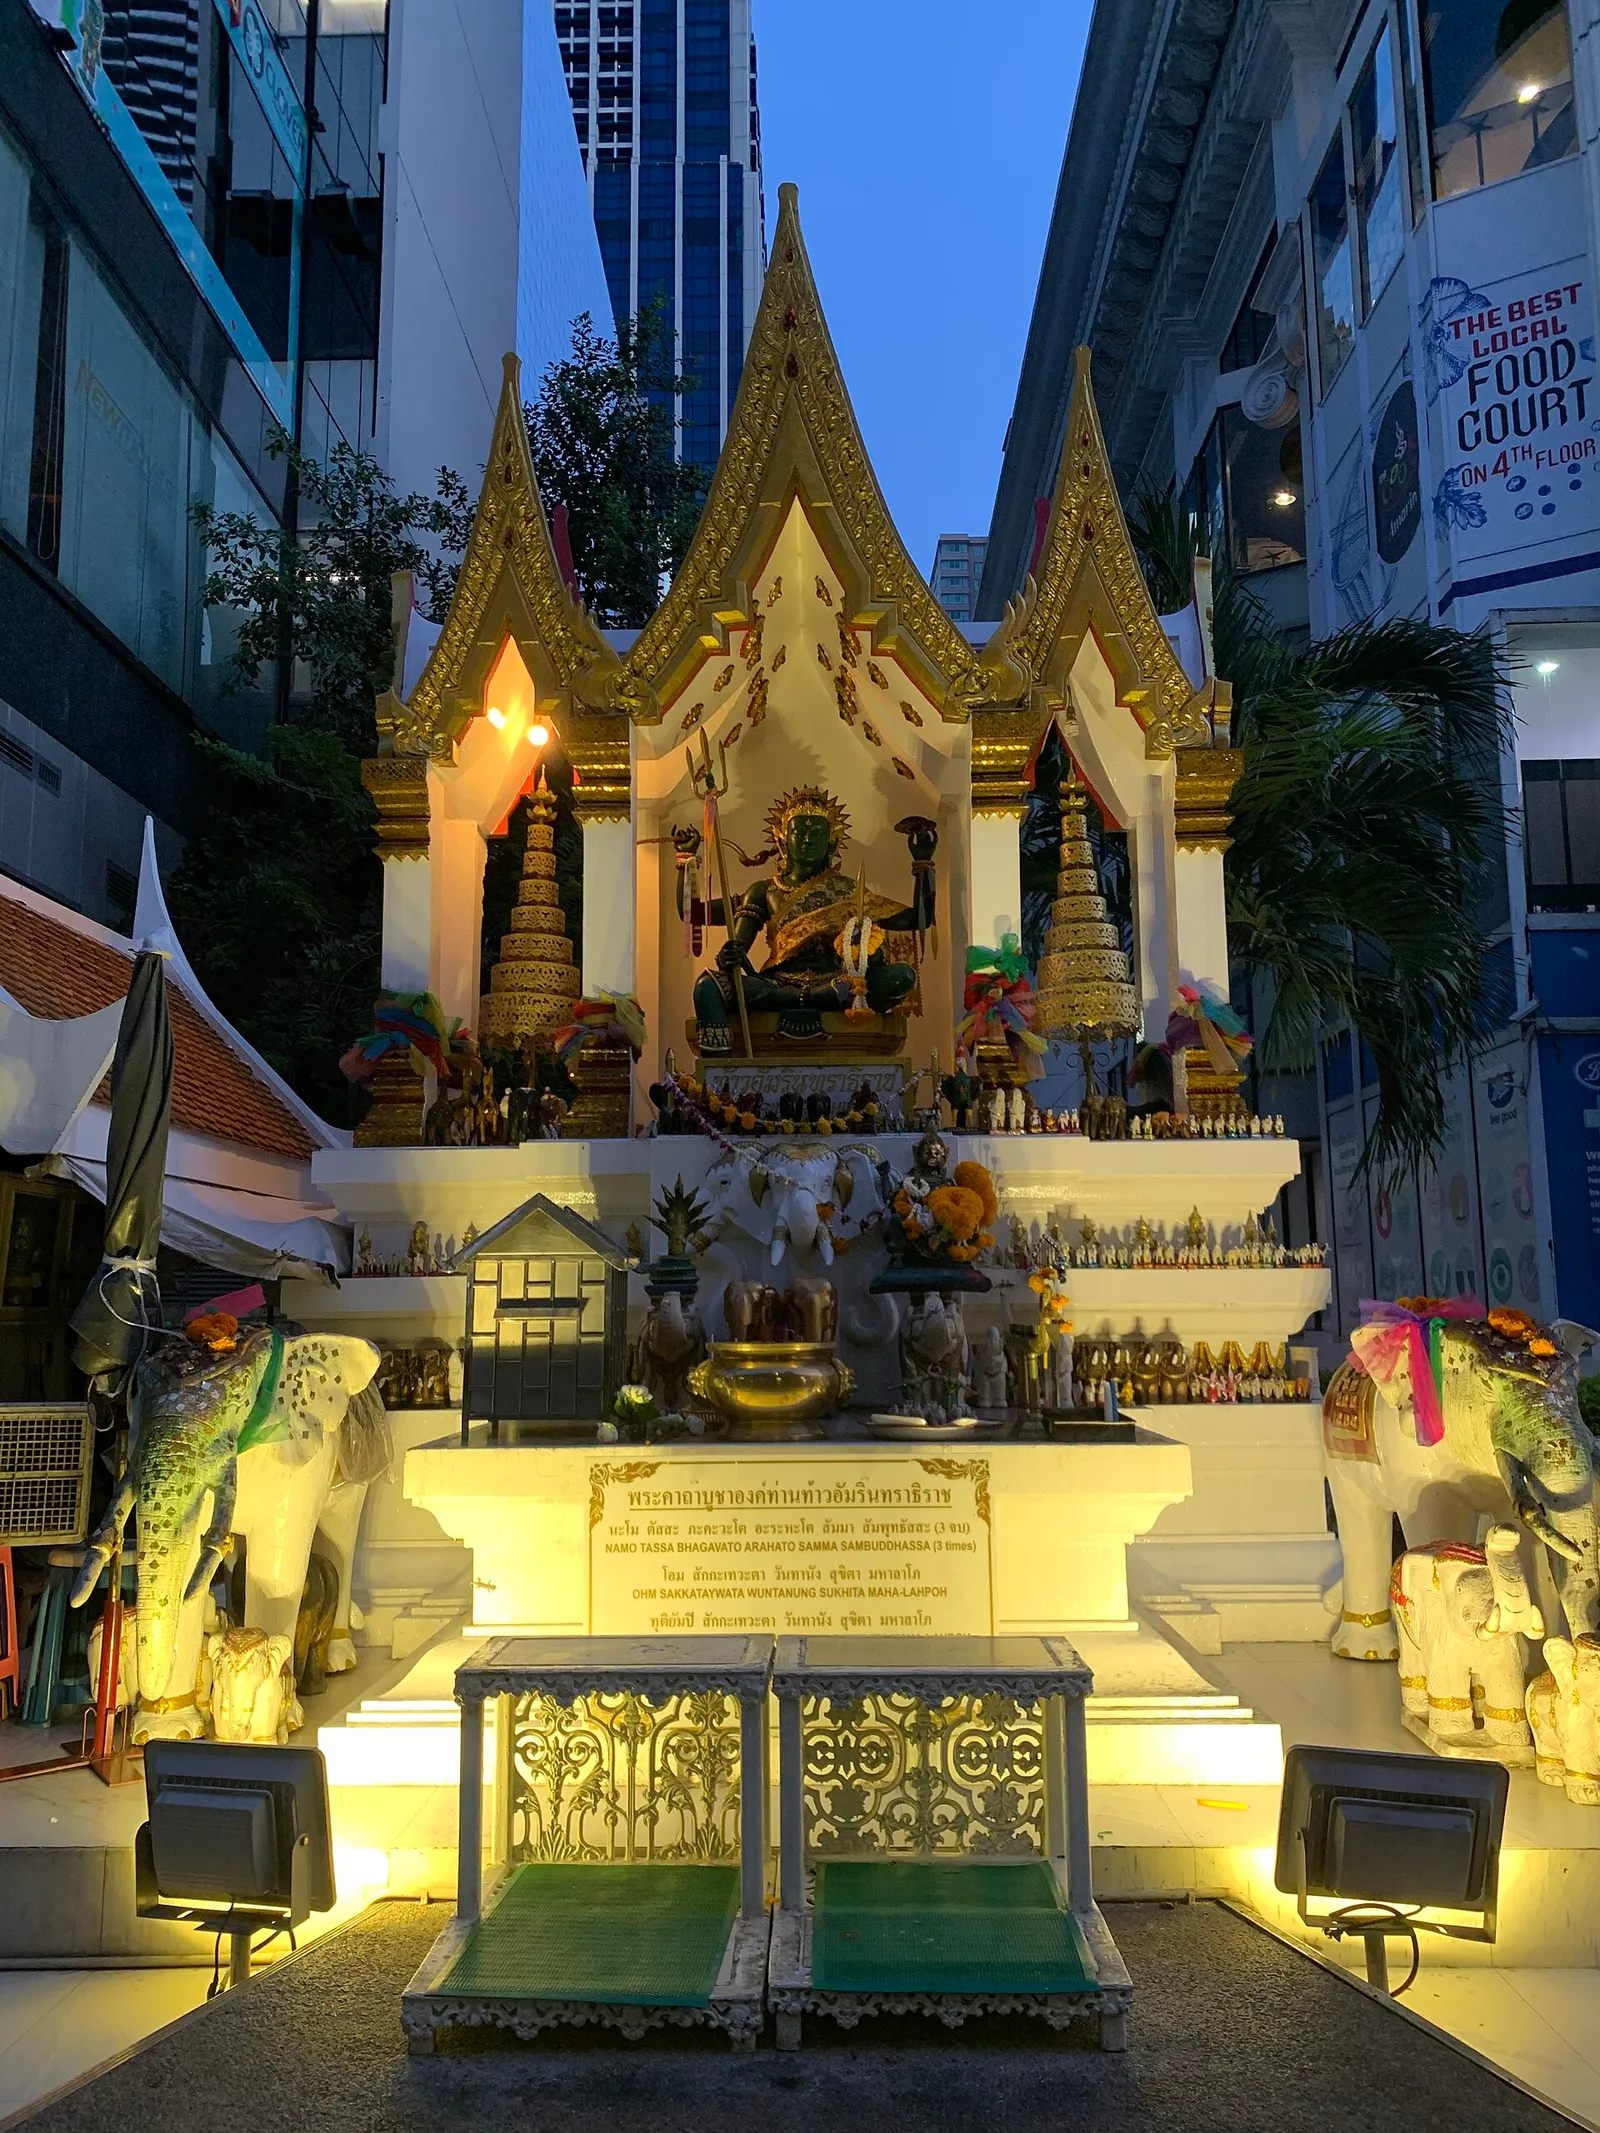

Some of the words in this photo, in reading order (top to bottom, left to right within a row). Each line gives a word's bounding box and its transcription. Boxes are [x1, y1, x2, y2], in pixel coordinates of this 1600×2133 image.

[1448, 307, 1503, 340] THE
[1508, 282, 1583, 323] BEST
[1472, 315, 1568, 359] LOCAL
[1467, 338, 1576, 406] FOOD
[1457, 376, 1593, 452] COURT
[1461, 463, 1488, 488] ON
[1491, 442, 1533, 479] 4TH
[1535, 438, 1597, 470] FLOOR
[609, 1520, 639, 1536] นะโม
[647, 1520, 679, 1536] ตัสสะ
[688, 1518, 747, 1535] ภะคะวะโต
[755, 1518, 814, 1535] อะระหะโต
[822, 1518, 854, 1534] สัมมา
[862, 1518, 931, 1537] สัมพุทธัสสะ
[934, 1522, 946, 1536] (3
[949, 1522, 970, 1536] จบ)
[605, 1542, 637, 1553] NAMO
[640, 1542, 675, 1553] TASSA
[677, 1541, 742, 1553] BHAGAVATO
[744, 1541, 796, 1552] ARAHATO
[798, 1540, 838, 1552] SAMMA
[840, 1540, 931, 1552] SAMBUDDHASSA
[933, 1541, 943, 1552] (3
[944, 1540, 977, 1552] times)
[662, 1565, 685, 1581] โอม
[693, 1565, 766, 1581] สักกะเทวะตา
[774, 1564, 821, 1581] วันทานัง
[830, 1564, 861, 1584] สุขิตา
[868, 1563, 921, 1580] มหาลาโภ
[632, 1588, 657, 1599] OHM
[660, 1588, 745, 1599] SAKKATAYWATA
[747, 1587, 816, 1598] WUNTANUNG
[819, 1587, 865, 1598] SUKHITA
[868, 1586, 948, 1598] MAHA-LAHPOH
[703, 1611, 776, 1628] สักกะเทวะตา
[784, 1611, 832, 1627] วันทานัง
[880, 1609, 932, 1626] มหาลาโภ
